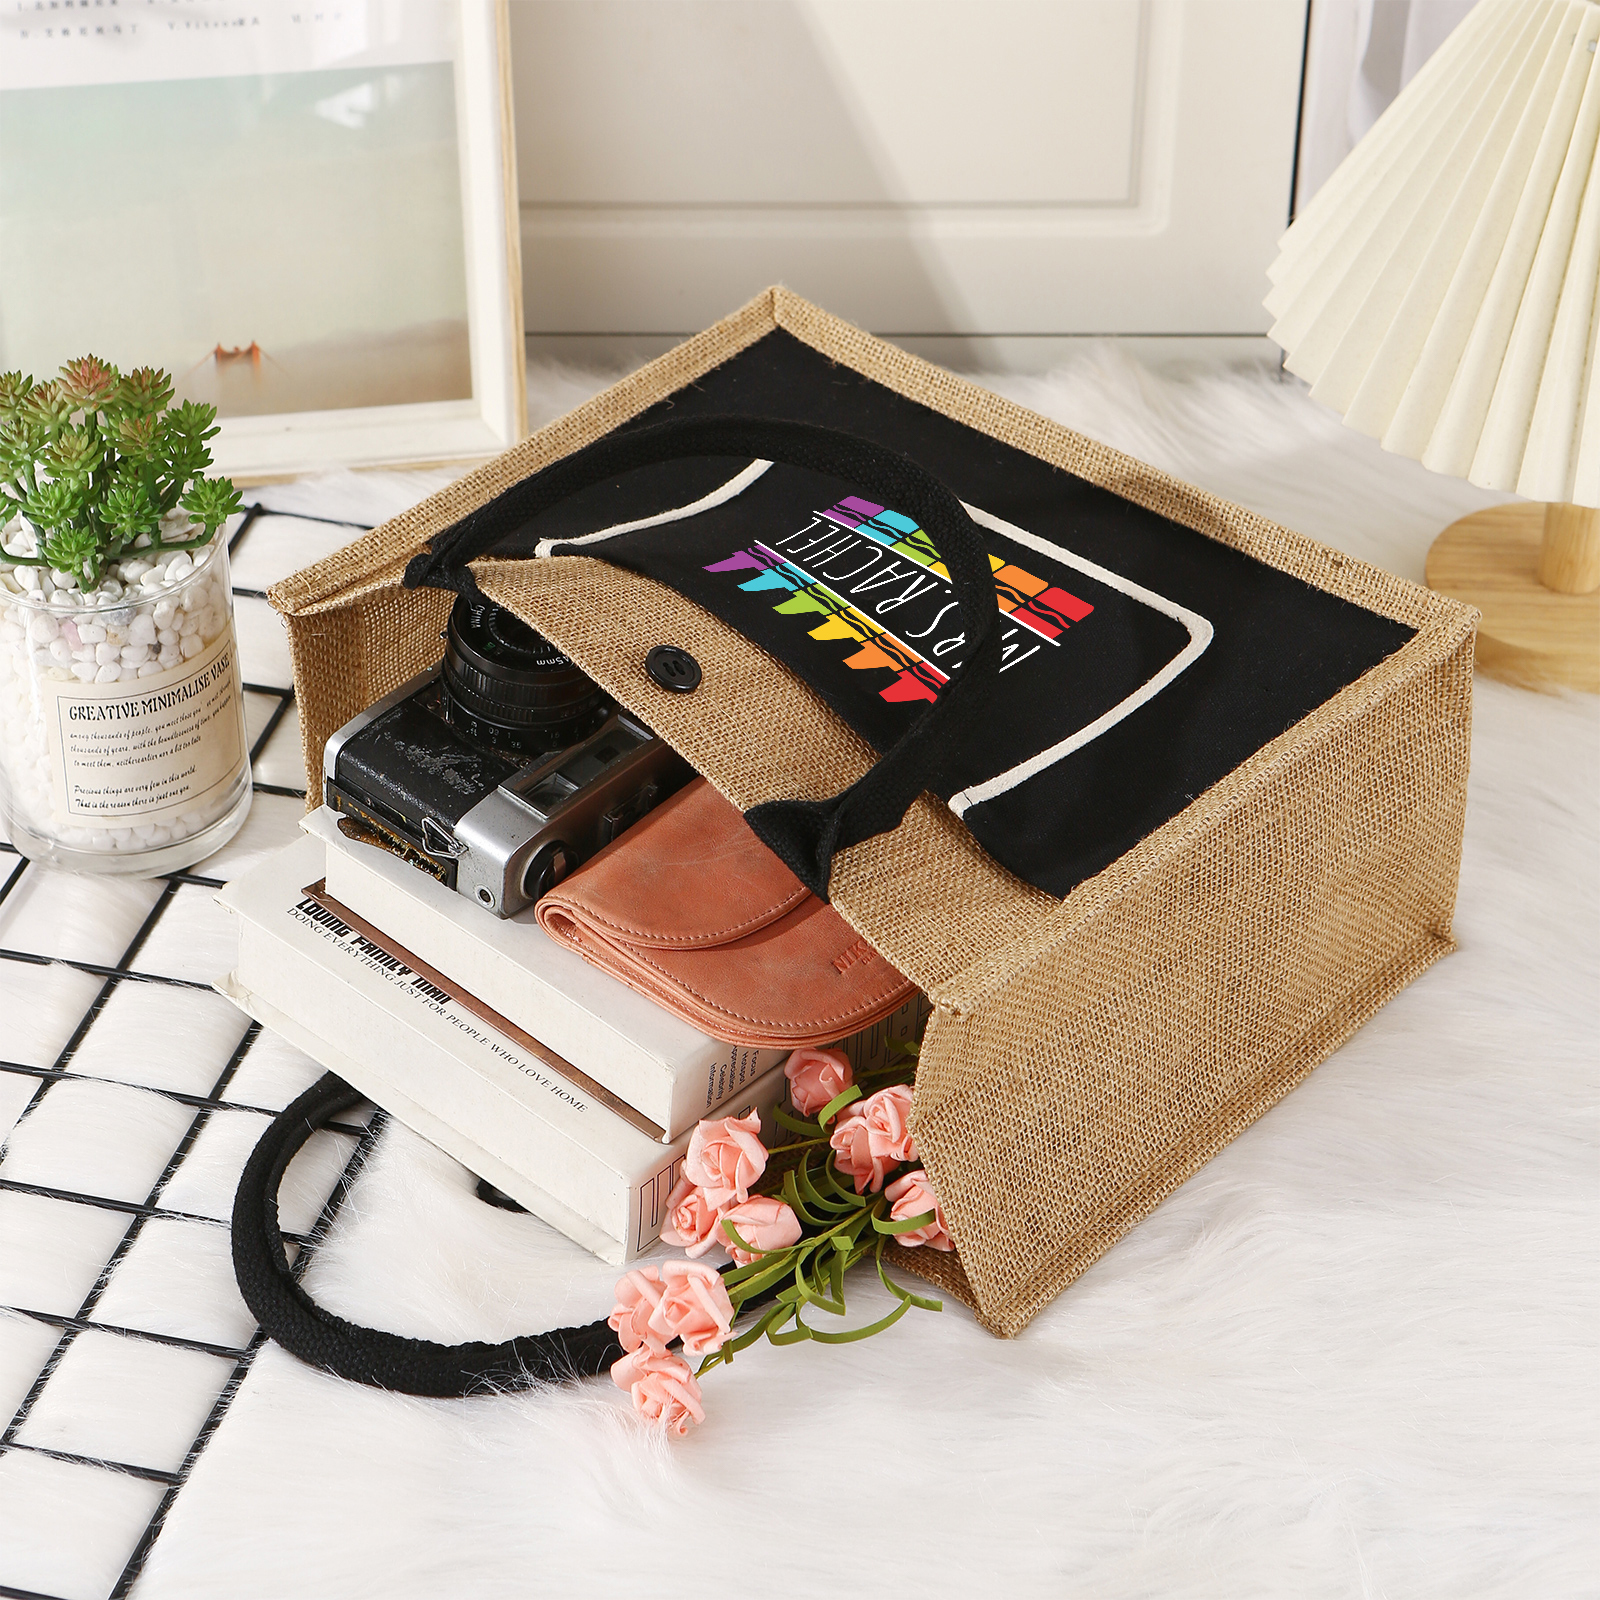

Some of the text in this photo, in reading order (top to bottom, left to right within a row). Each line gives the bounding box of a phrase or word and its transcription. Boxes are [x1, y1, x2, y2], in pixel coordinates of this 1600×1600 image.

[470, 604, 486, 629] CHINA
[69, 652, 230, 721] GREATIVE MINIMALISE VASE
[69, 732, 89, 742] among
[90, 731, 122, 740] thousands
[123, 729, 131, 741] of
[154, 724, 165, 734] you
[166, 717, 179, 727] meet
[70, 744, 102, 754] thousands
[103, 745, 110, 757] of
[132, 739, 147, 750] with
[147, 737, 157, 748] the
[194, 719, 200, 731] of
[73, 759, 80, 767] to
[81, 759, 96, 768] meet
[174, 743, 182, 753] bit
[182, 741, 191, 750] too
[191, 735, 201, 746] late
[74, 784, 101, 795] Precious
[102, 785, 122, 797] things
[135, 784, 149, 793] very
[149, 780, 160, 791] few
[161, 777, 168, 785] in
[168, 774, 180, 784] this
[75, 798, 91, 808] That
[99, 800, 109, 809] the
[131, 797, 148, 807] there
[148, 795, 155, 803] is
[155, 791, 169, 804] just
[169, 789, 179, 797] one
[350, 935, 413, 977] FAMILY
[410, 977, 453, 1006] MAN
[286, 907, 589, 1113] DOING EVERYTHING JUST FOR PEOPLE WHO LOVE HOME
[738, 1051, 749, 1085] Hotspot
[750, 1049, 760, 1077] Focus
[705, 1062, 717, 1109] Information
[715, 1063, 728, 1100] Celebrity
